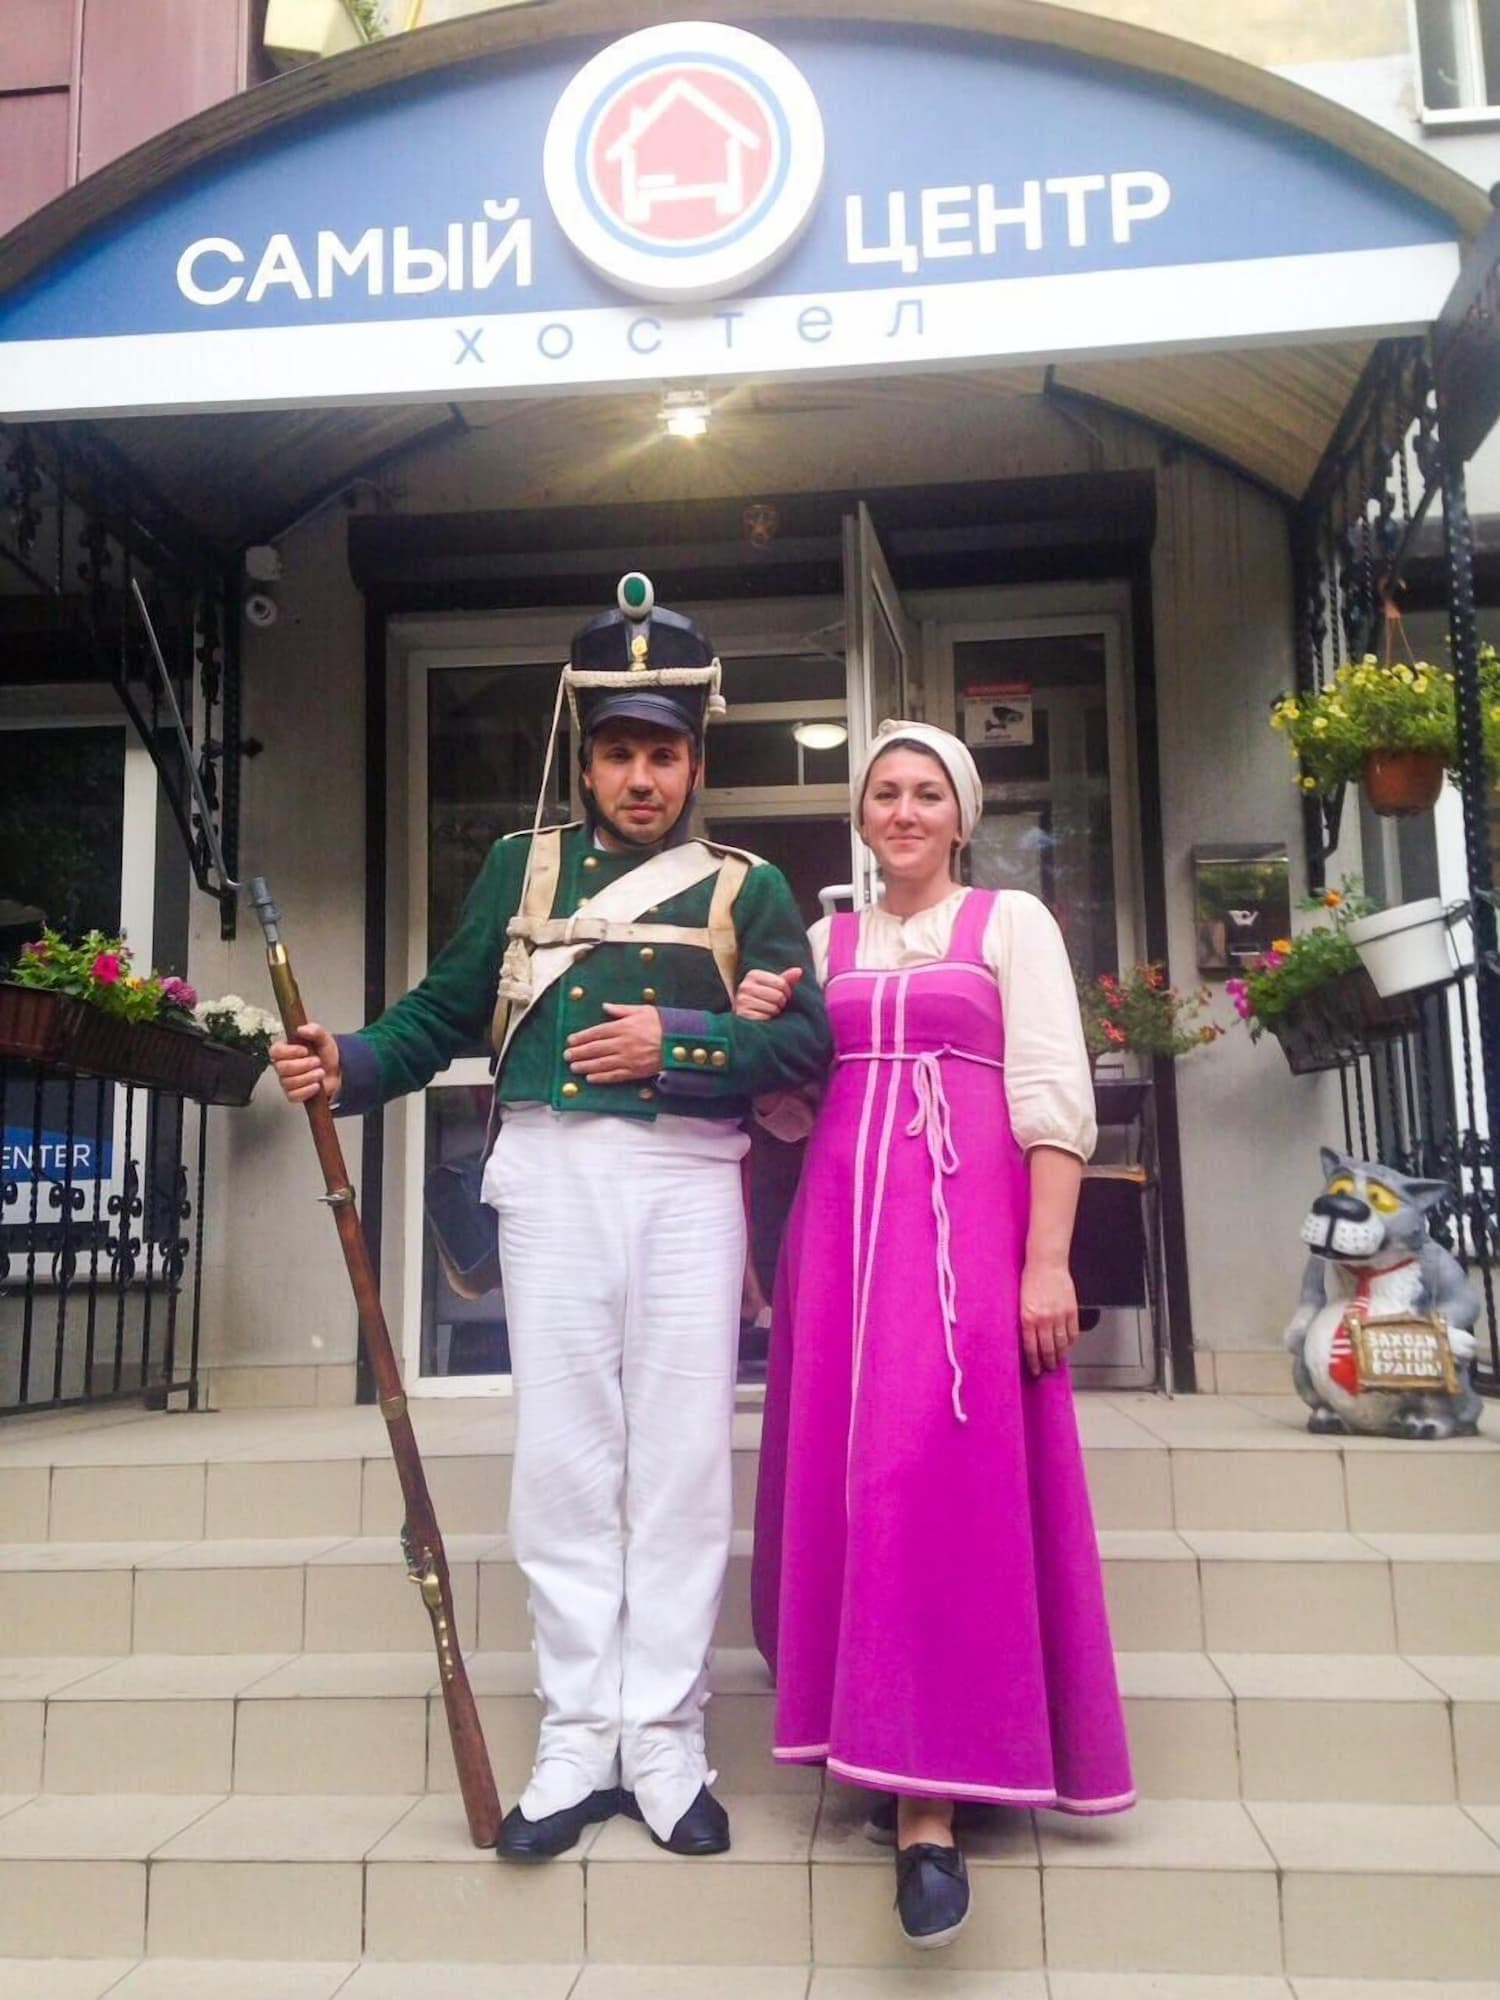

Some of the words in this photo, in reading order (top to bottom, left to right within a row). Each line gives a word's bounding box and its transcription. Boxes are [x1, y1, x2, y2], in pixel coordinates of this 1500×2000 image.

[177, 198, 532, 305] САМЫЙ
[845, 170, 1171, 273] ЦЕНТР
[454, 298, 925, 365] хостел
